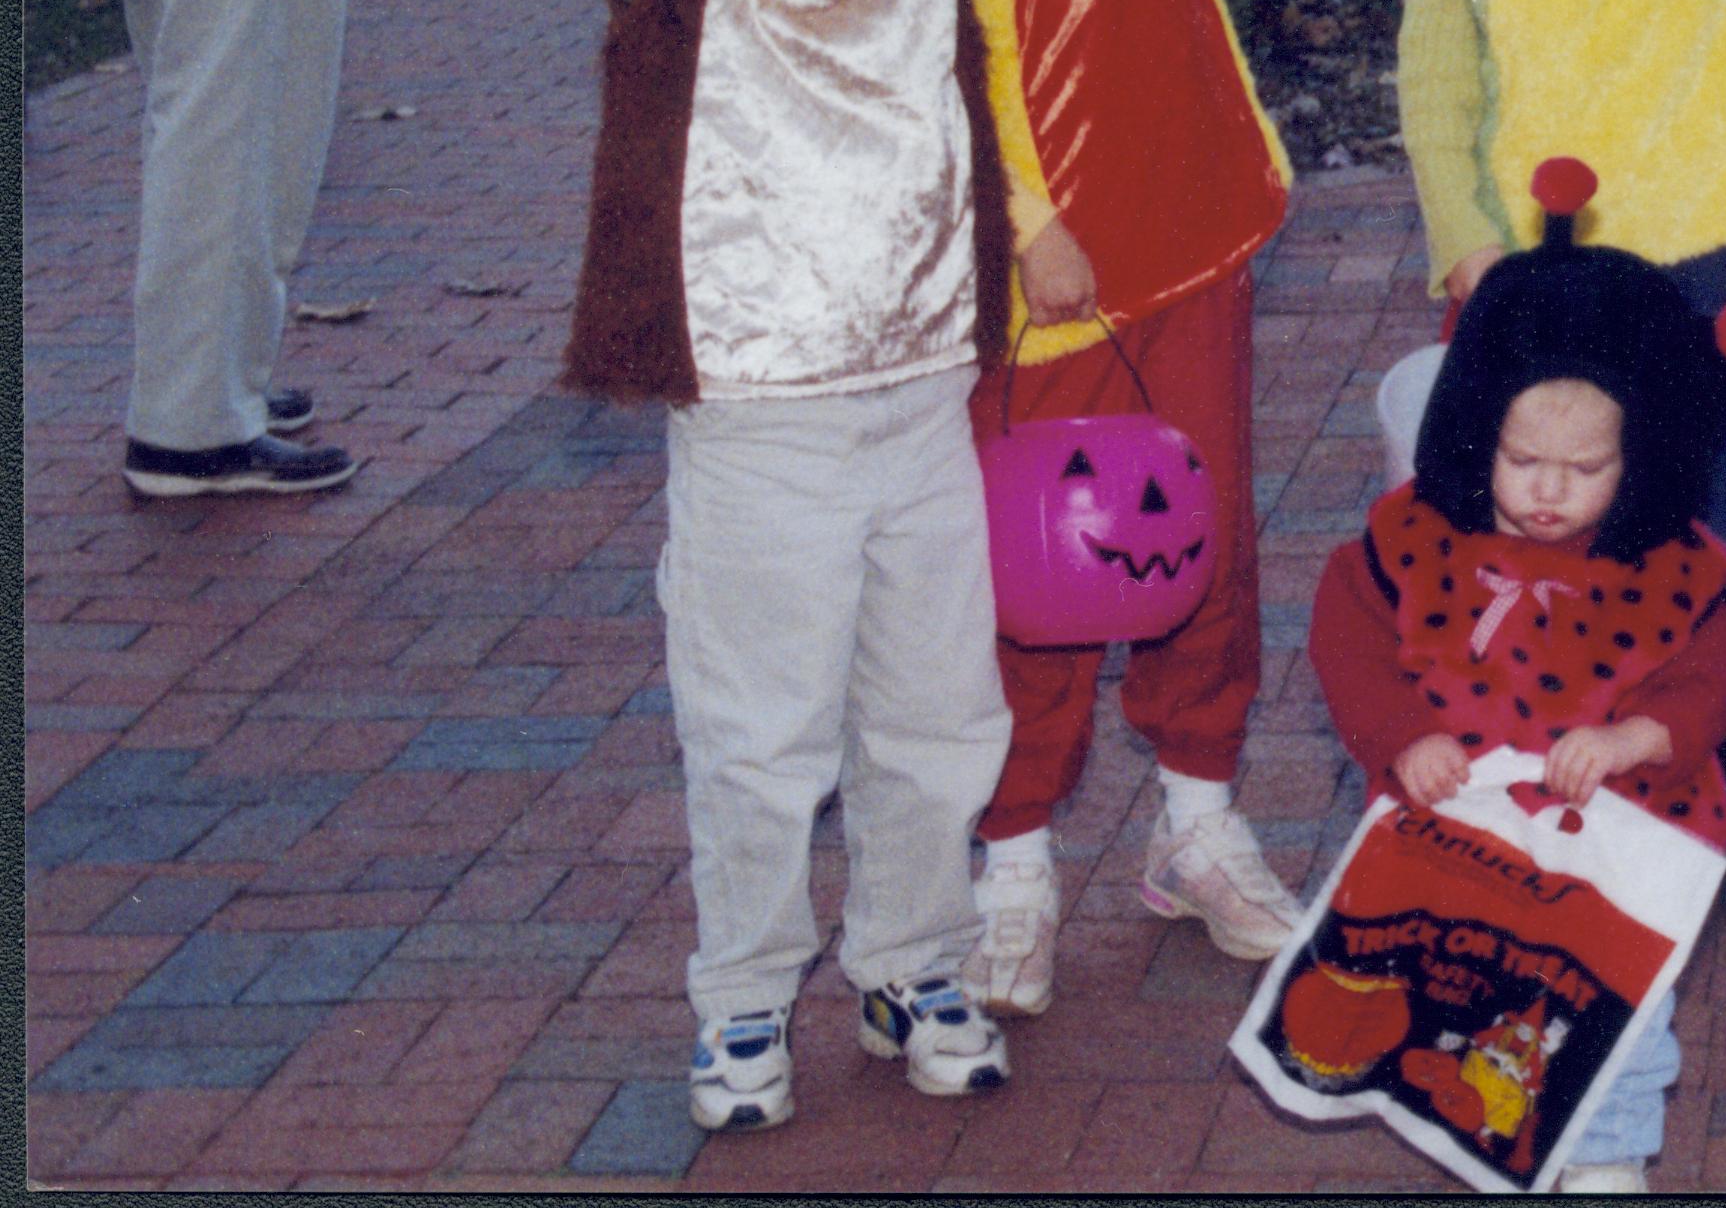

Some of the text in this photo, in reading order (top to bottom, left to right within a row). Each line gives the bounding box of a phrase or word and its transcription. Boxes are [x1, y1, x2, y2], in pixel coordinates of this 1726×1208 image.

[1342, 919, 1598, 1012] TRICK OR TREAT
